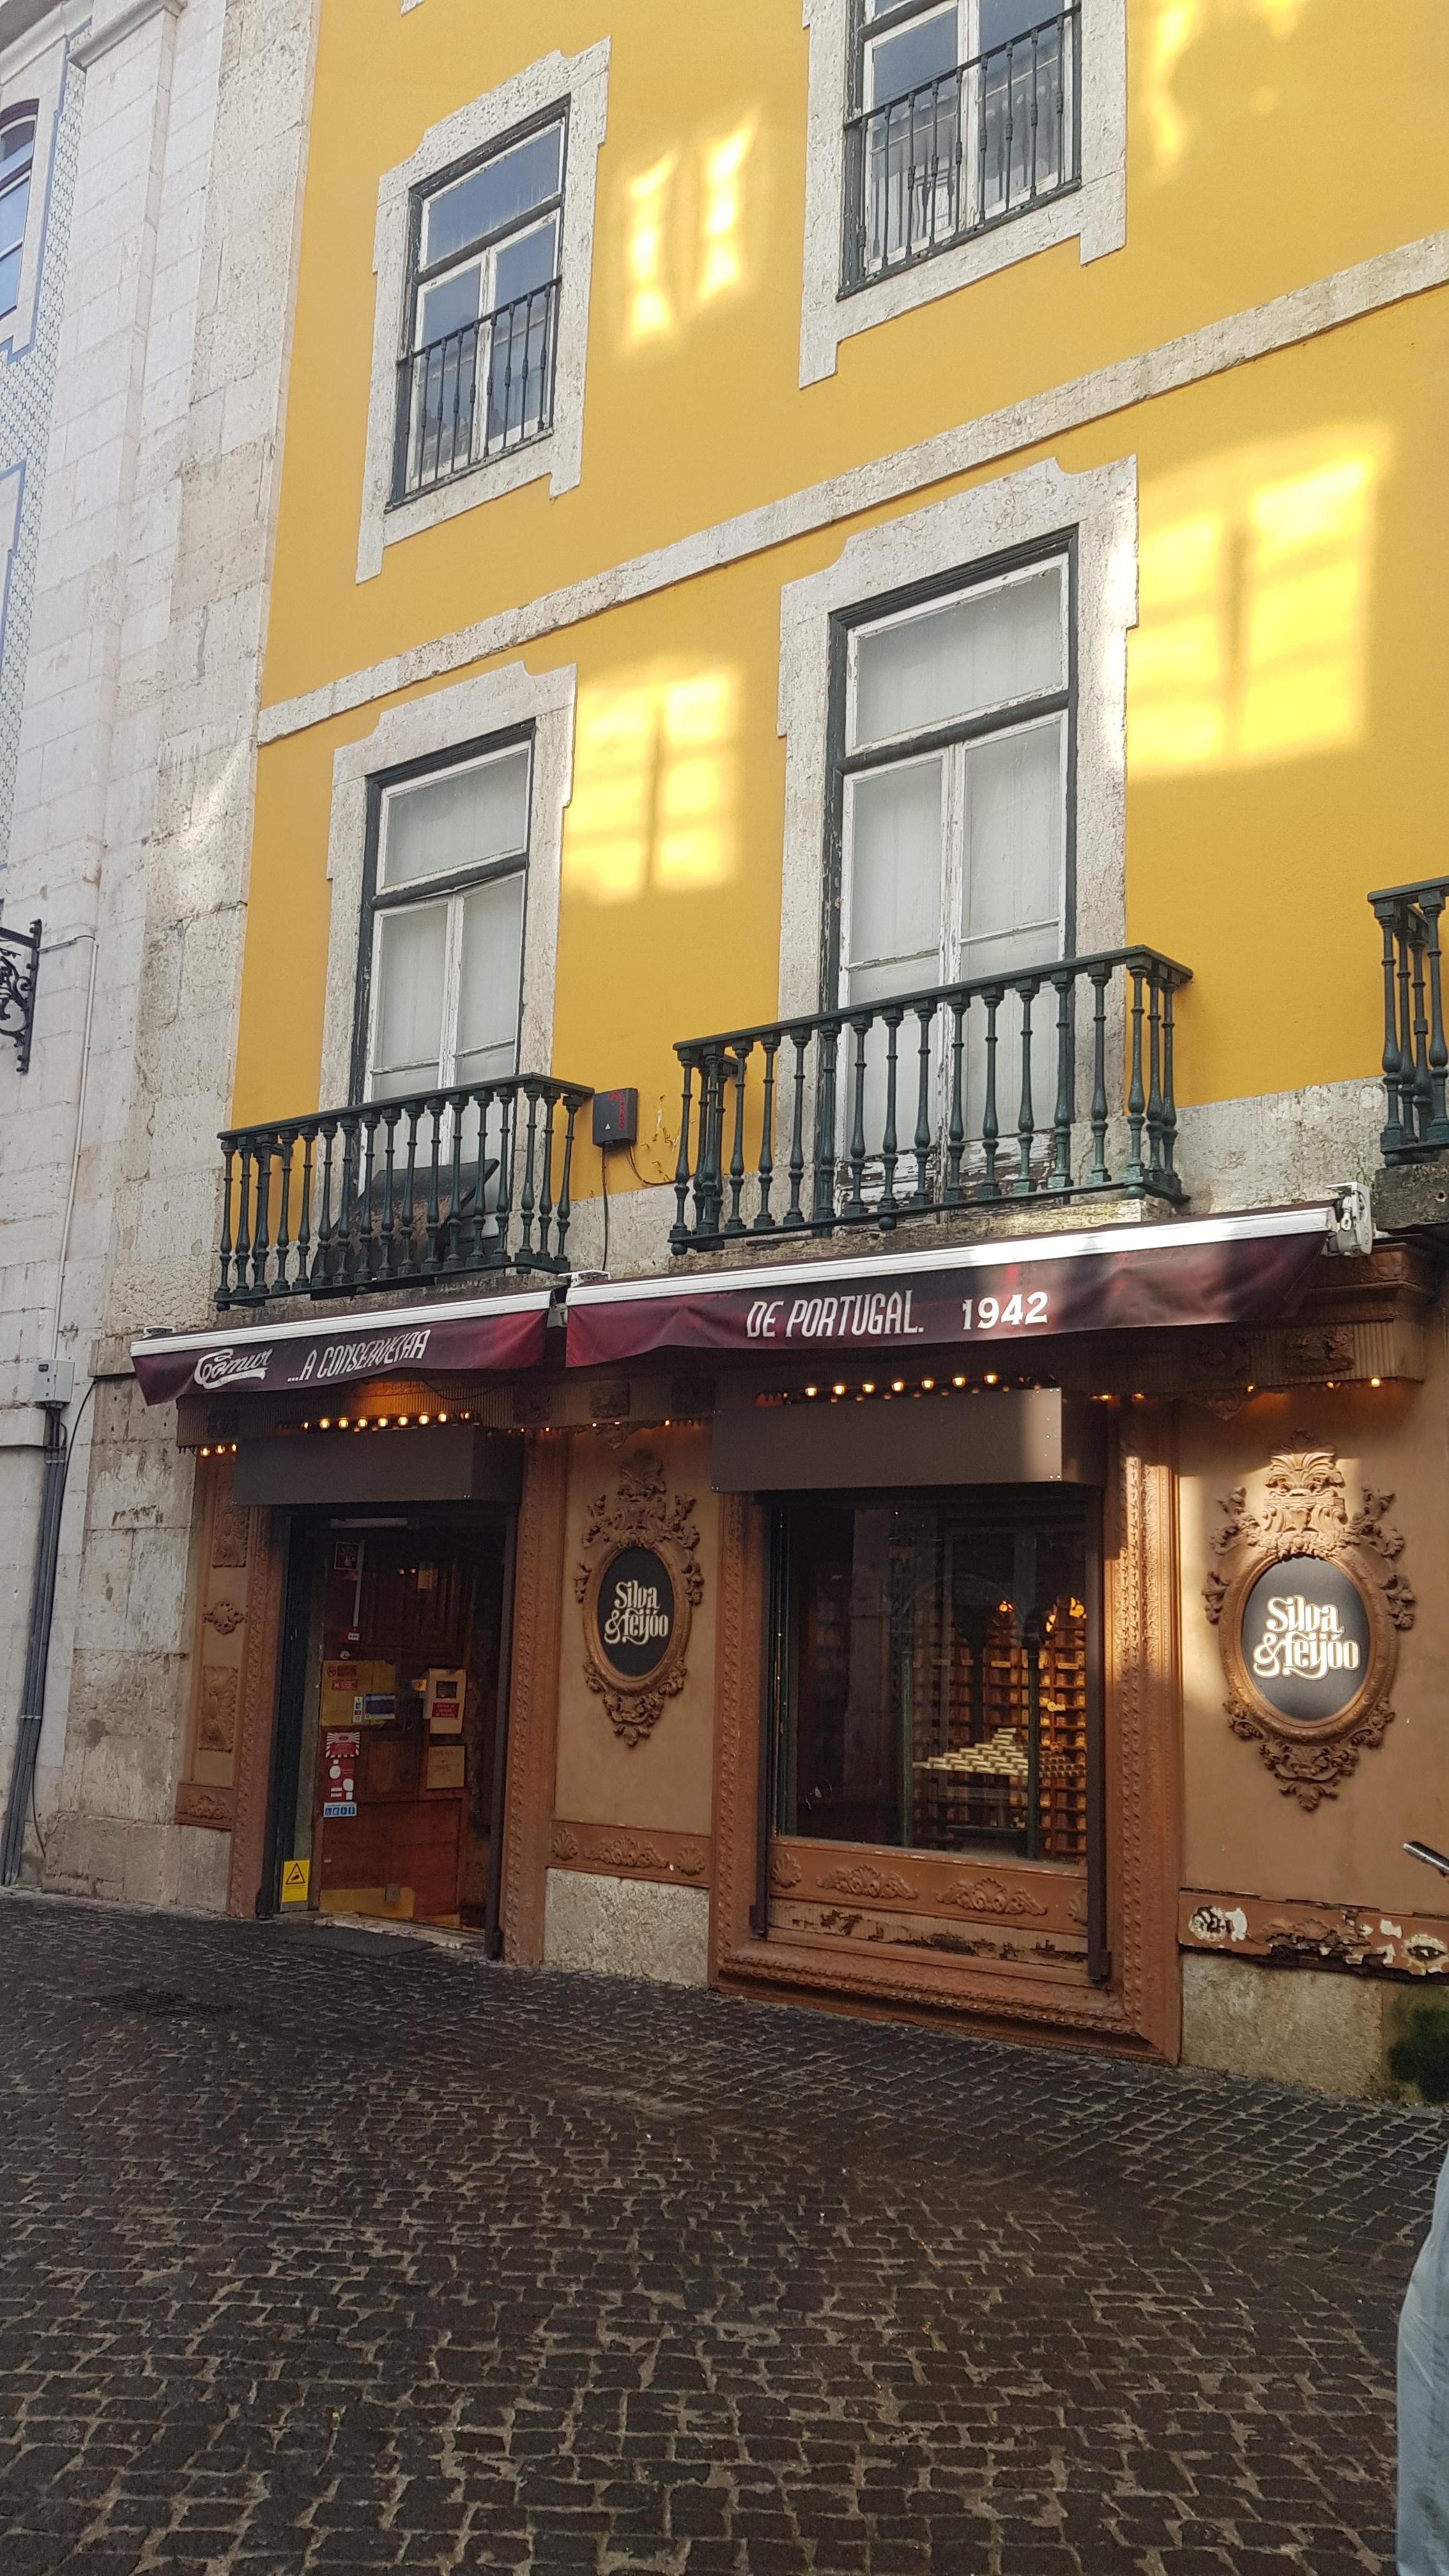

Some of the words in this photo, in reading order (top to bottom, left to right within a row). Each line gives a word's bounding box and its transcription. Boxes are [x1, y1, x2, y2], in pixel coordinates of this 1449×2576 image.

[746, 1300, 785, 1338] DE
[785, 1290, 924, 1338] PORTUGAL.
[962, 1291, 1048, 1330] 1942
[317, 1330, 431, 1379] CONSERVEIRA
[614, 1579, 661, 1609] Silva
[1266, 1595, 1345, 1634] Silva
